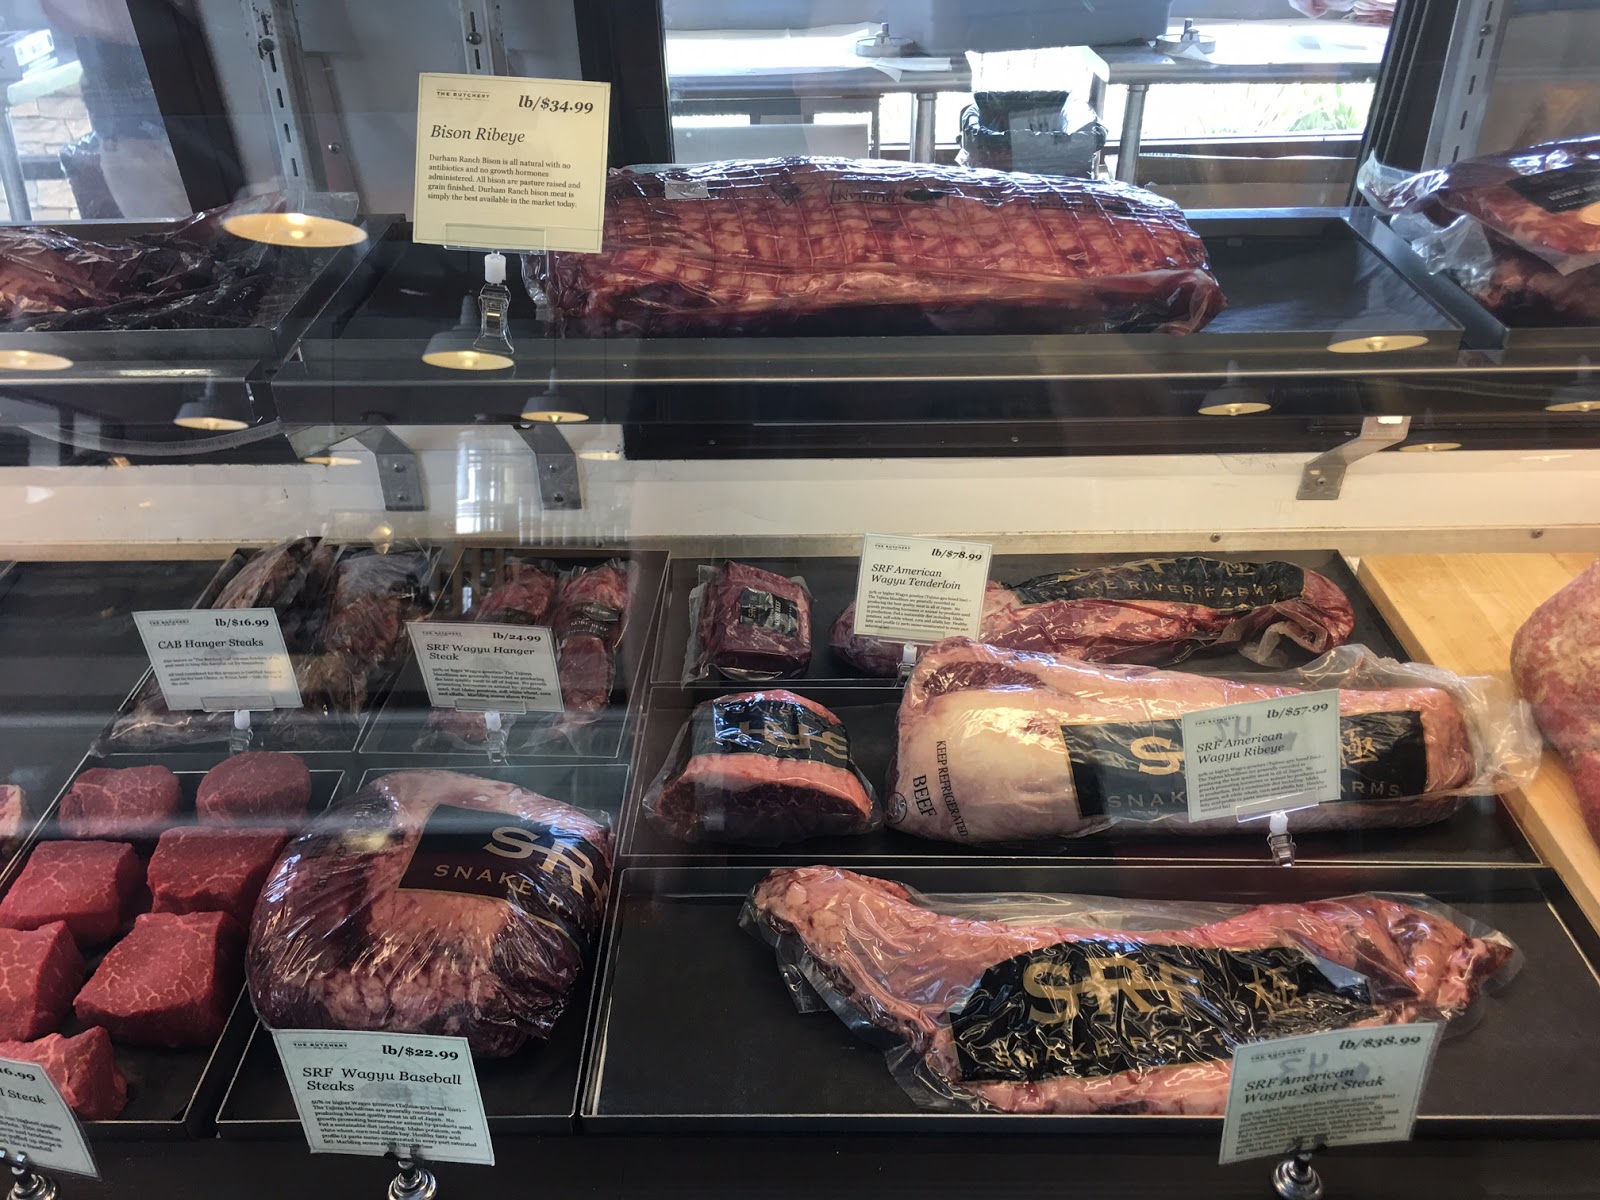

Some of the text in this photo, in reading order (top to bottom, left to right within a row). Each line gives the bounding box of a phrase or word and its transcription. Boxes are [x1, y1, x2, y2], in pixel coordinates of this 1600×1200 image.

[518, 95, 594, 114] lb/$34.99
[430, 125, 525, 146] Bison Ribeye
[429, 154, 457, 162] Durham
[482, 157, 501, 165] Bison
[509, 158, 518, 166] all
[428, 164, 464, 172] antibiotics
[515, 168, 549, 177] hormones
[428, 173, 474, 182] administered.
[487, 176, 506, 184] bison
[447, 183, 476, 192] finished.
[478, 185, 506, 193] Durham
[507, 187, 529, 195] Ranch
[530, 188, 549, 196] bison
[427, 193, 450, 201] simply
[464, 194, 478, 202] best
[519, 197, 530, 205] the
[557, 200, 576, 209] today.
[931, 548, 982, 561] lb/$78.99
[871, 564, 942, 577] SRF American
[872, 574, 961, 590] Wagyu Tenderloin
[1127, 579, 1195, 596] RIVER
[1205, 582, 1279, 598] FARMS
[215, 618, 269, 628] lb/$16.99
[158, 638, 264, 649] CAB Hanger Steaks
[493, 632, 541, 642] lb/24.99
[429, 652, 459, 661] Steak
[452, 644, 490, 654] Wagyu
[494, 646, 535, 656] Hanger
[1267, 703, 1329, 719] lb/$57.99
[1197, 732, 1283, 753] SRF American
[1198, 743, 1284, 765] Wagyu Ribeye
[912, 774, 938, 817] BEEF
[936, 741, 969, 837] KEEP REFRIGERATED
[1107, 780, 1400, 808] SNAK ARMS
[433, 864, 536, 897] SNAKE
[1339, 1036, 1421, 1050] lb/$38.99
[382, 1044, 459, 1061] lb/$22.99
[303, 1067, 461, 1085] SRF Wagyu Baseball
[1245, 1068, 1355, 1091] SRF American
[307, 1080, 355, 1091] Steaks
[1244, 1076, 1385, 1104] Wagyu Skirt Steak
[8, 1088, 47, 1105] Steak
